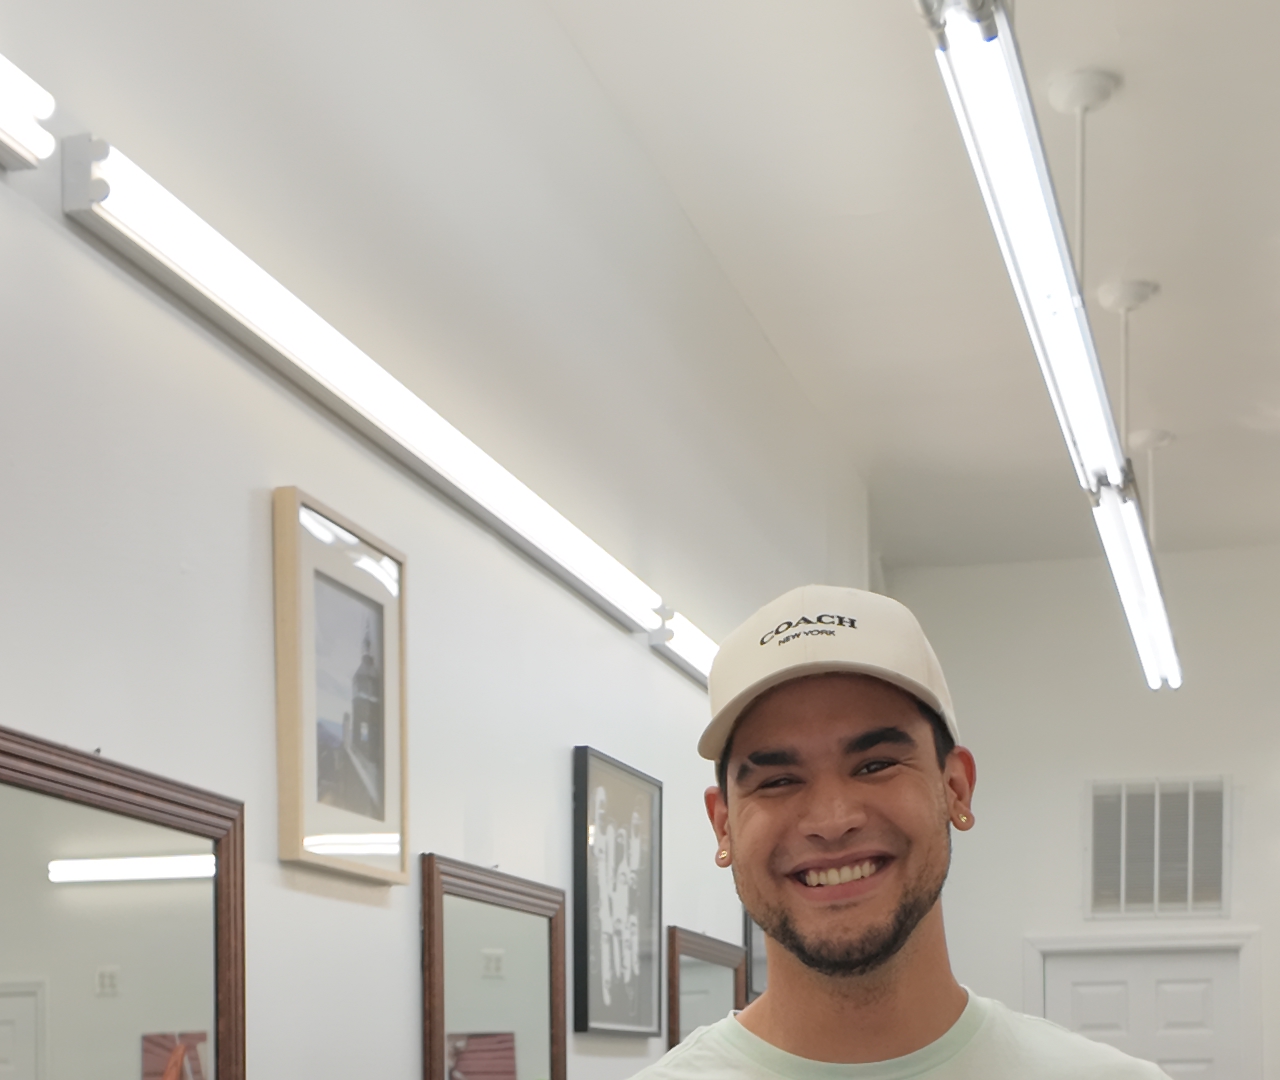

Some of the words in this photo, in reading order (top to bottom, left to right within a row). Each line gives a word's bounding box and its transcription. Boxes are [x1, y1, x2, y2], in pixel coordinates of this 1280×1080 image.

[760, 614, 857, 646] COACH
[778, 632, 801, 646] NEW
[803, 629, 836, 637] YORK
